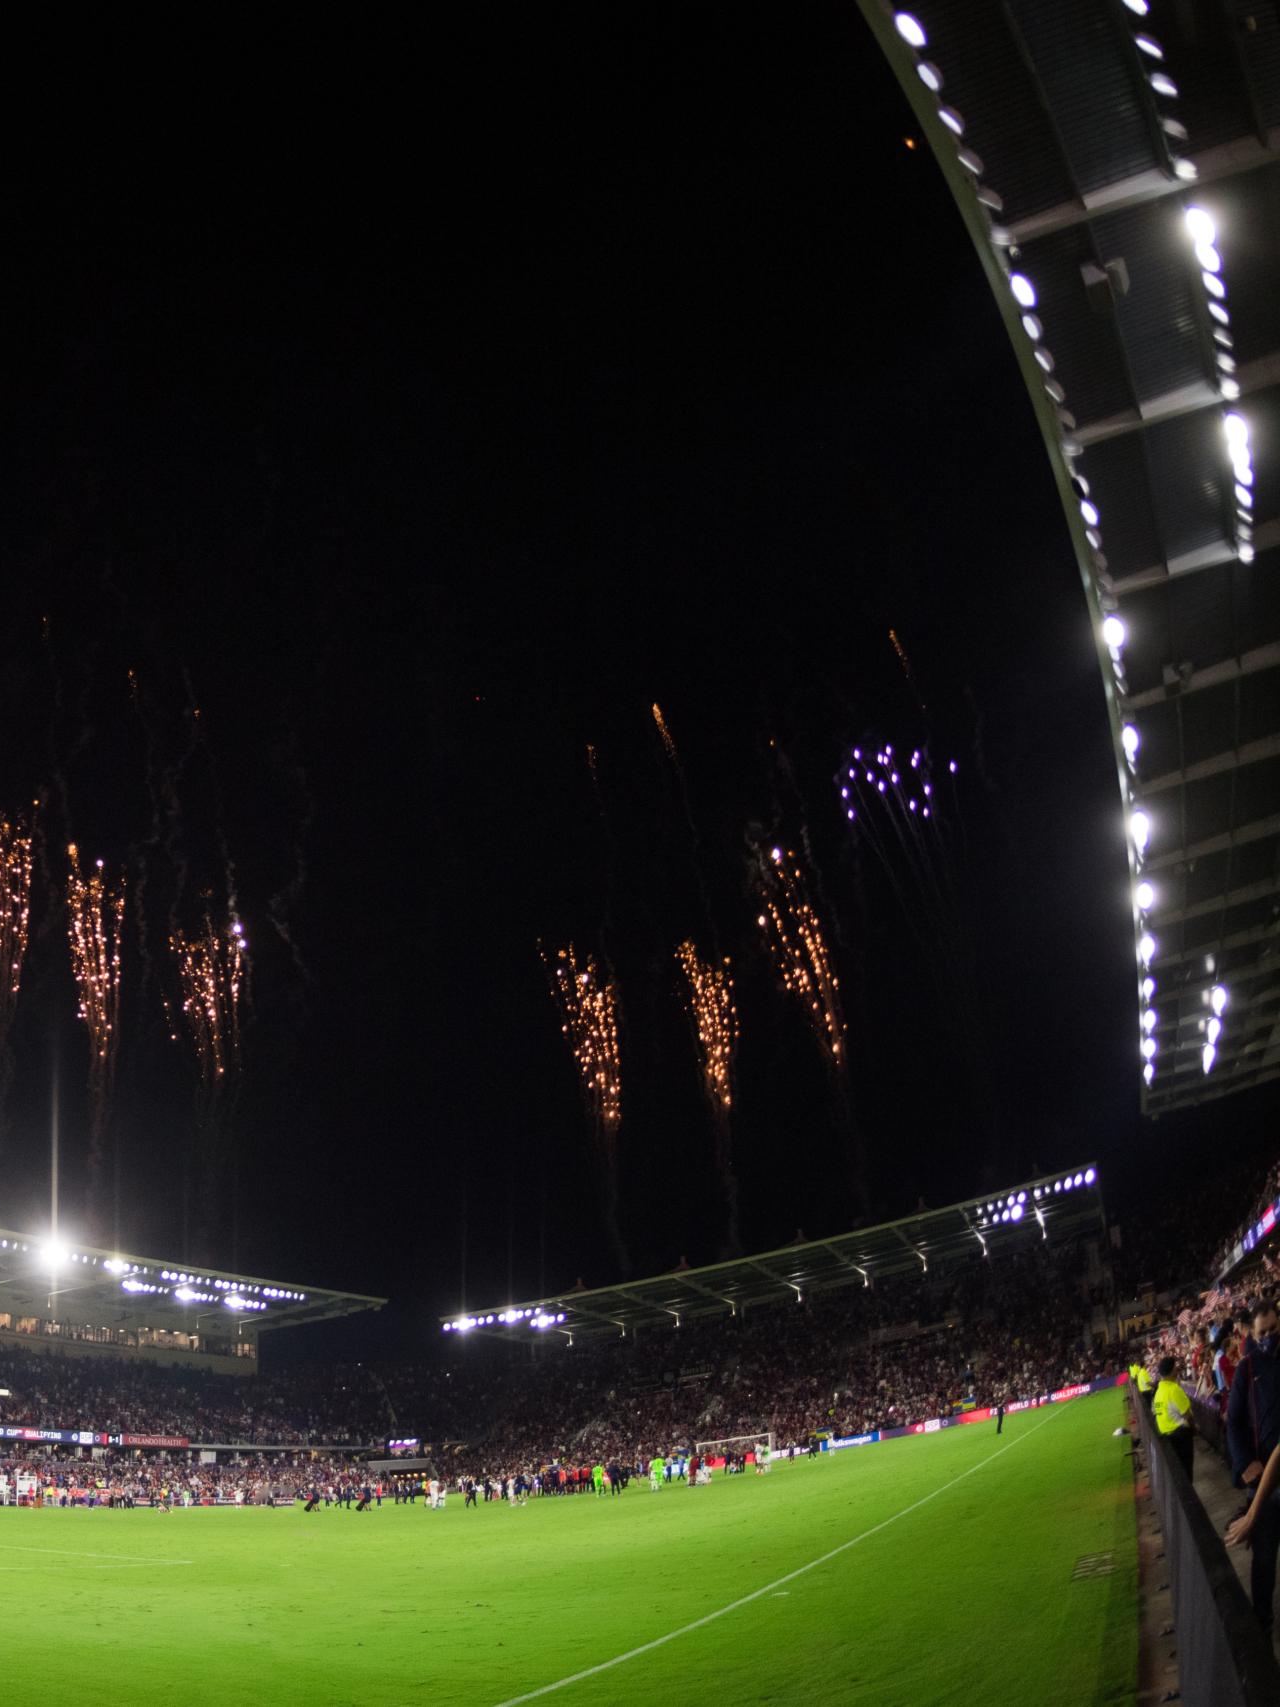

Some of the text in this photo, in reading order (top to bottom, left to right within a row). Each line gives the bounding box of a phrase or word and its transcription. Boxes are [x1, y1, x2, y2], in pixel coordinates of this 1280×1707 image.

[1008, 1400, 1029, 1411] WORLD
[1051, 1385, 1090, 1401] QUALIFYING
[24, 1430, 61, 1439] QUALIFYING
[128, 1436, 159, 1445] ORLANDO
[829, 1435, 872, 1448] olkswagen
